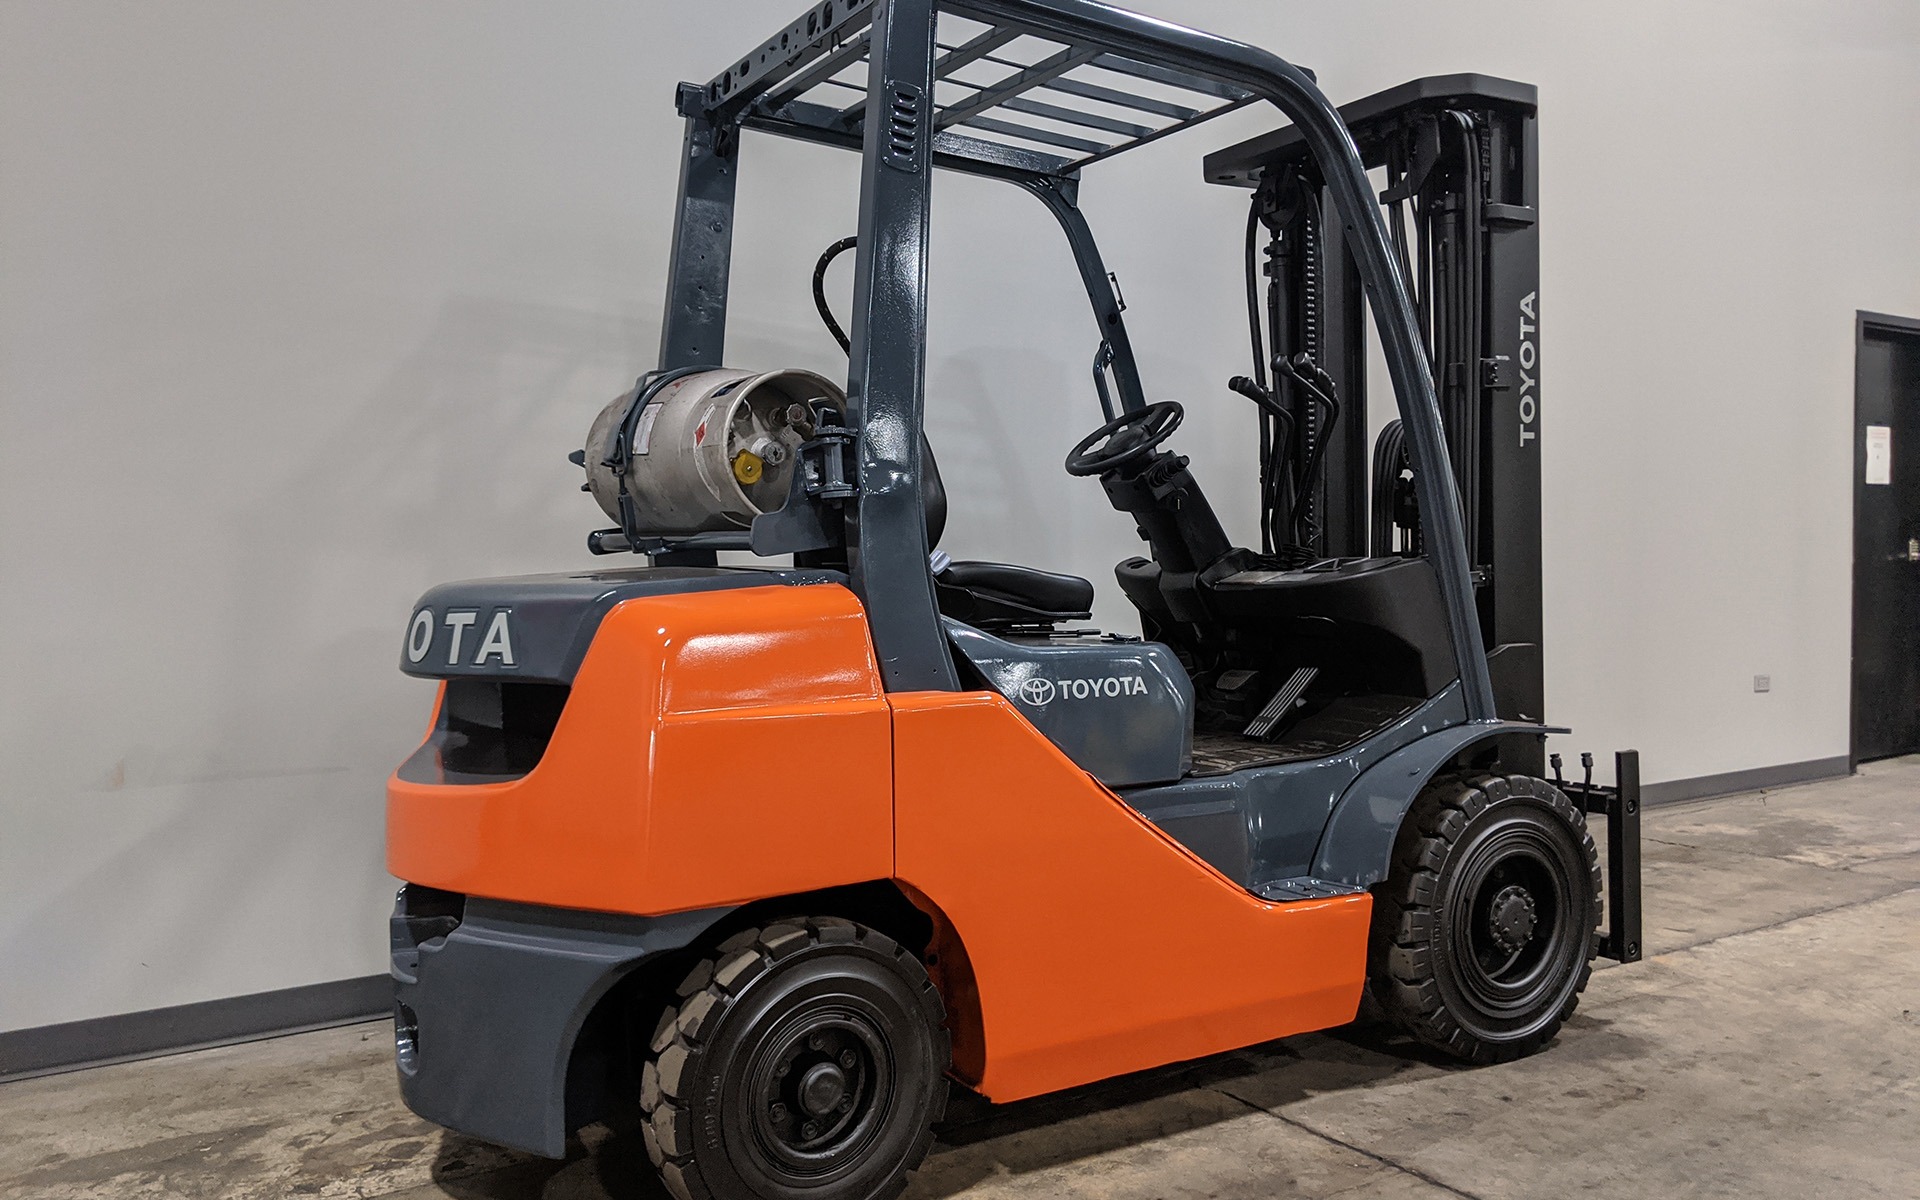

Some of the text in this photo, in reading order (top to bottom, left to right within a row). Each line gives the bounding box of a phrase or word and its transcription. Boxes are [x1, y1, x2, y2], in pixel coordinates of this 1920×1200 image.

[1519, 291, 1536, 448] TOYOTA
[408, 609, 514, 665] OTA
[1058, 676, 1148, 700] TOYOTA
